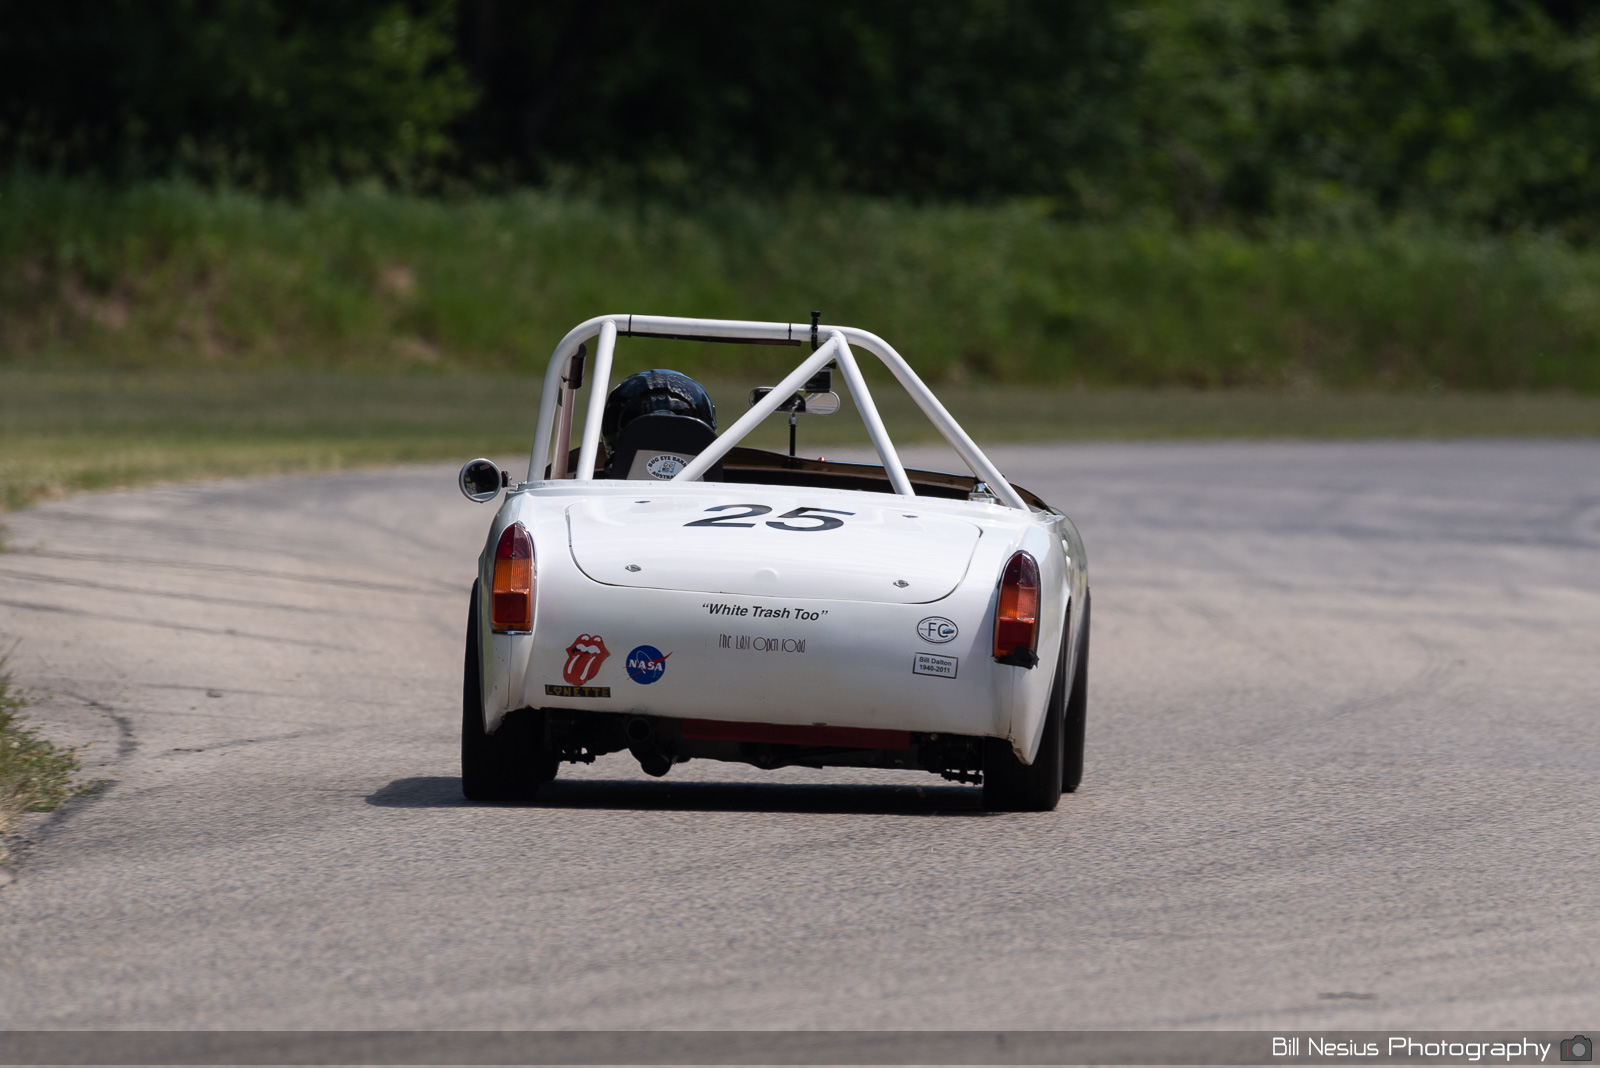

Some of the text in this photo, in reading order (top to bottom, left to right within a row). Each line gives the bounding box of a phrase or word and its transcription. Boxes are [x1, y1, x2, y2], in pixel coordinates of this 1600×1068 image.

[648, 457, 660, 468] BUG
[682, 503, 856, 532] 25
[702, 603, 828, 621] “White Trash Too”
[753, 636, 779, 653] Open
[629, 659, 663, 672] NASA
[919, 656, 952, 666] Bill Dalton
[919, 664, 950, 673] 1940-2011
